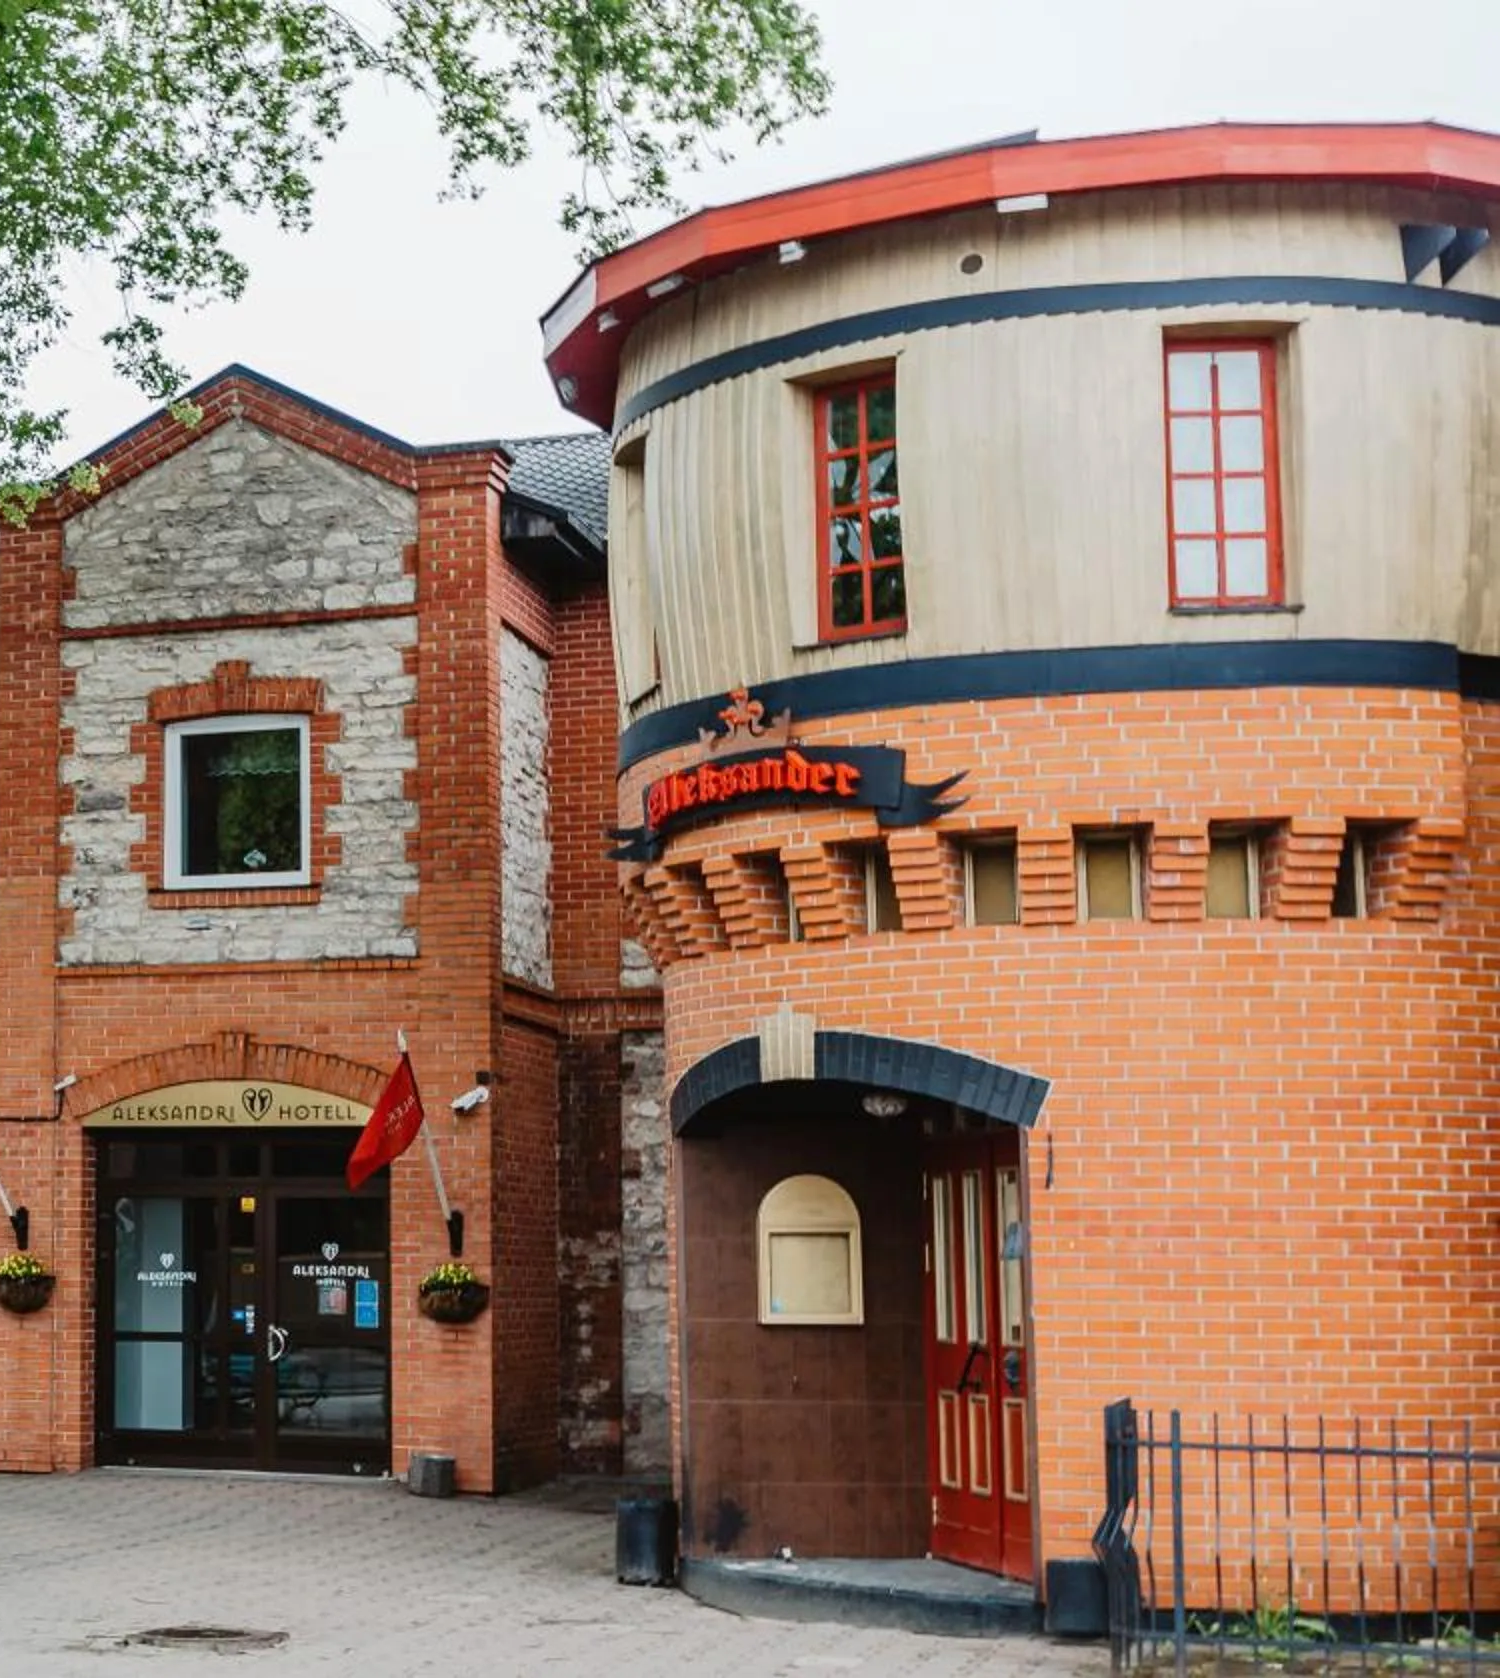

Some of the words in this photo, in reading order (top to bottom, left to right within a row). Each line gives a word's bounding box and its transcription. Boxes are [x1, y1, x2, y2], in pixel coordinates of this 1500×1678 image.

[647, 747, 861, 831] Aleksander
[113, 1104, 235, 1123] ALEKSANDRI
[279, 1104, 357, 1121] HOTELL
[292, 1265, 370, 1279] ALEKSANDRI
